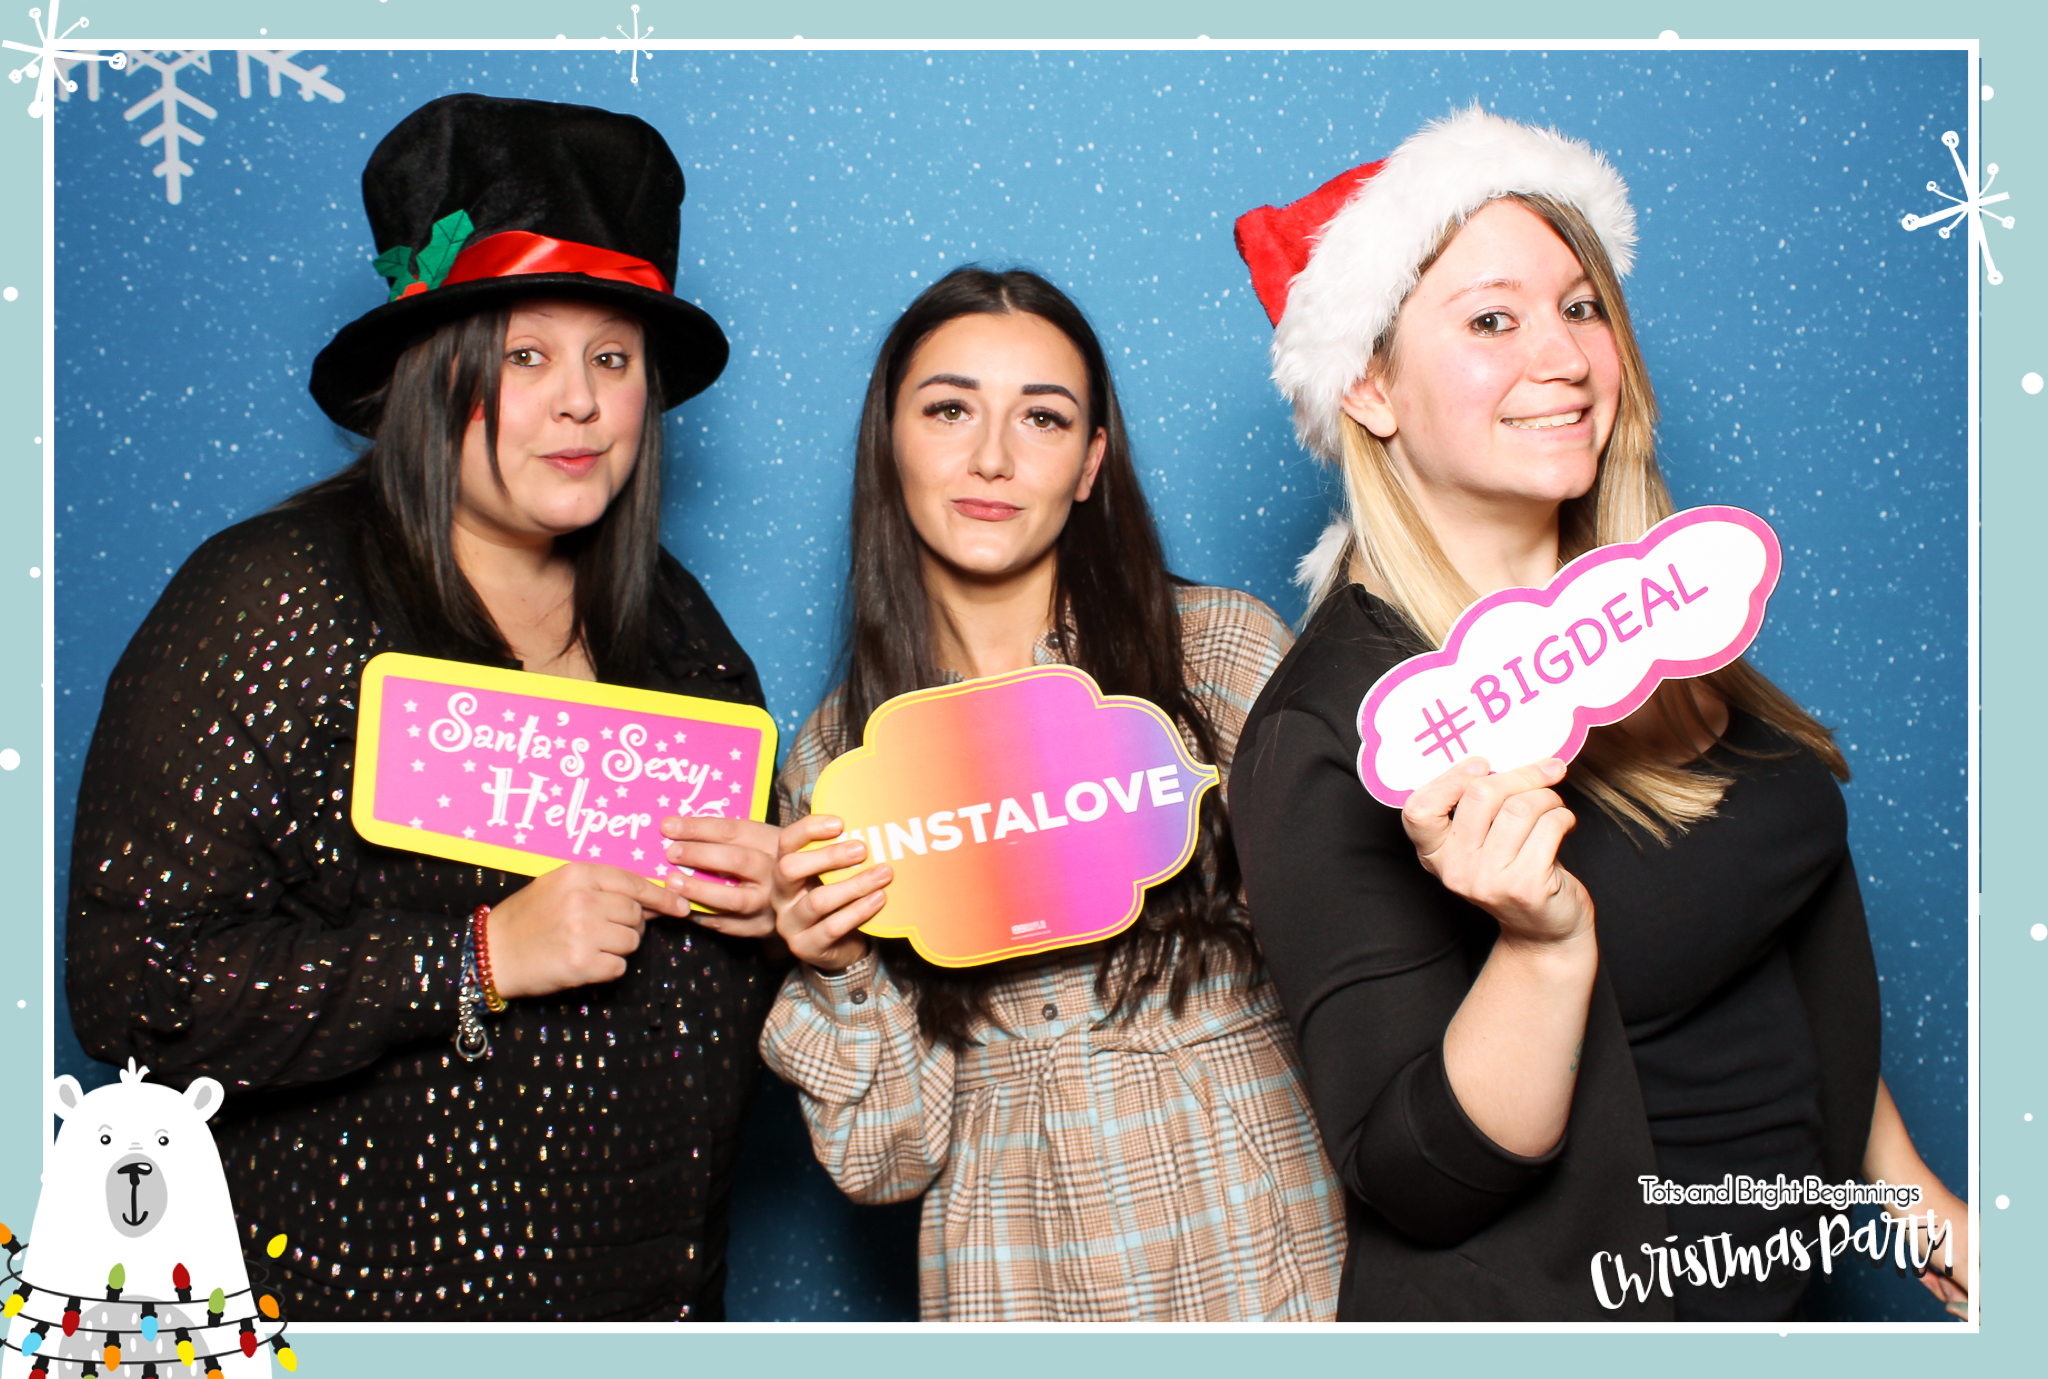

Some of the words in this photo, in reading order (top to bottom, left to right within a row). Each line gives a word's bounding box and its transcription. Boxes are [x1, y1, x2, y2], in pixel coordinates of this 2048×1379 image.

[1414, 563, 1709, 763] #BIGDEAL
[428, 692, 590, 777] Santa's
[601, 723, 711, 802] Sexy
[481, 764, 652, 855] Helper
